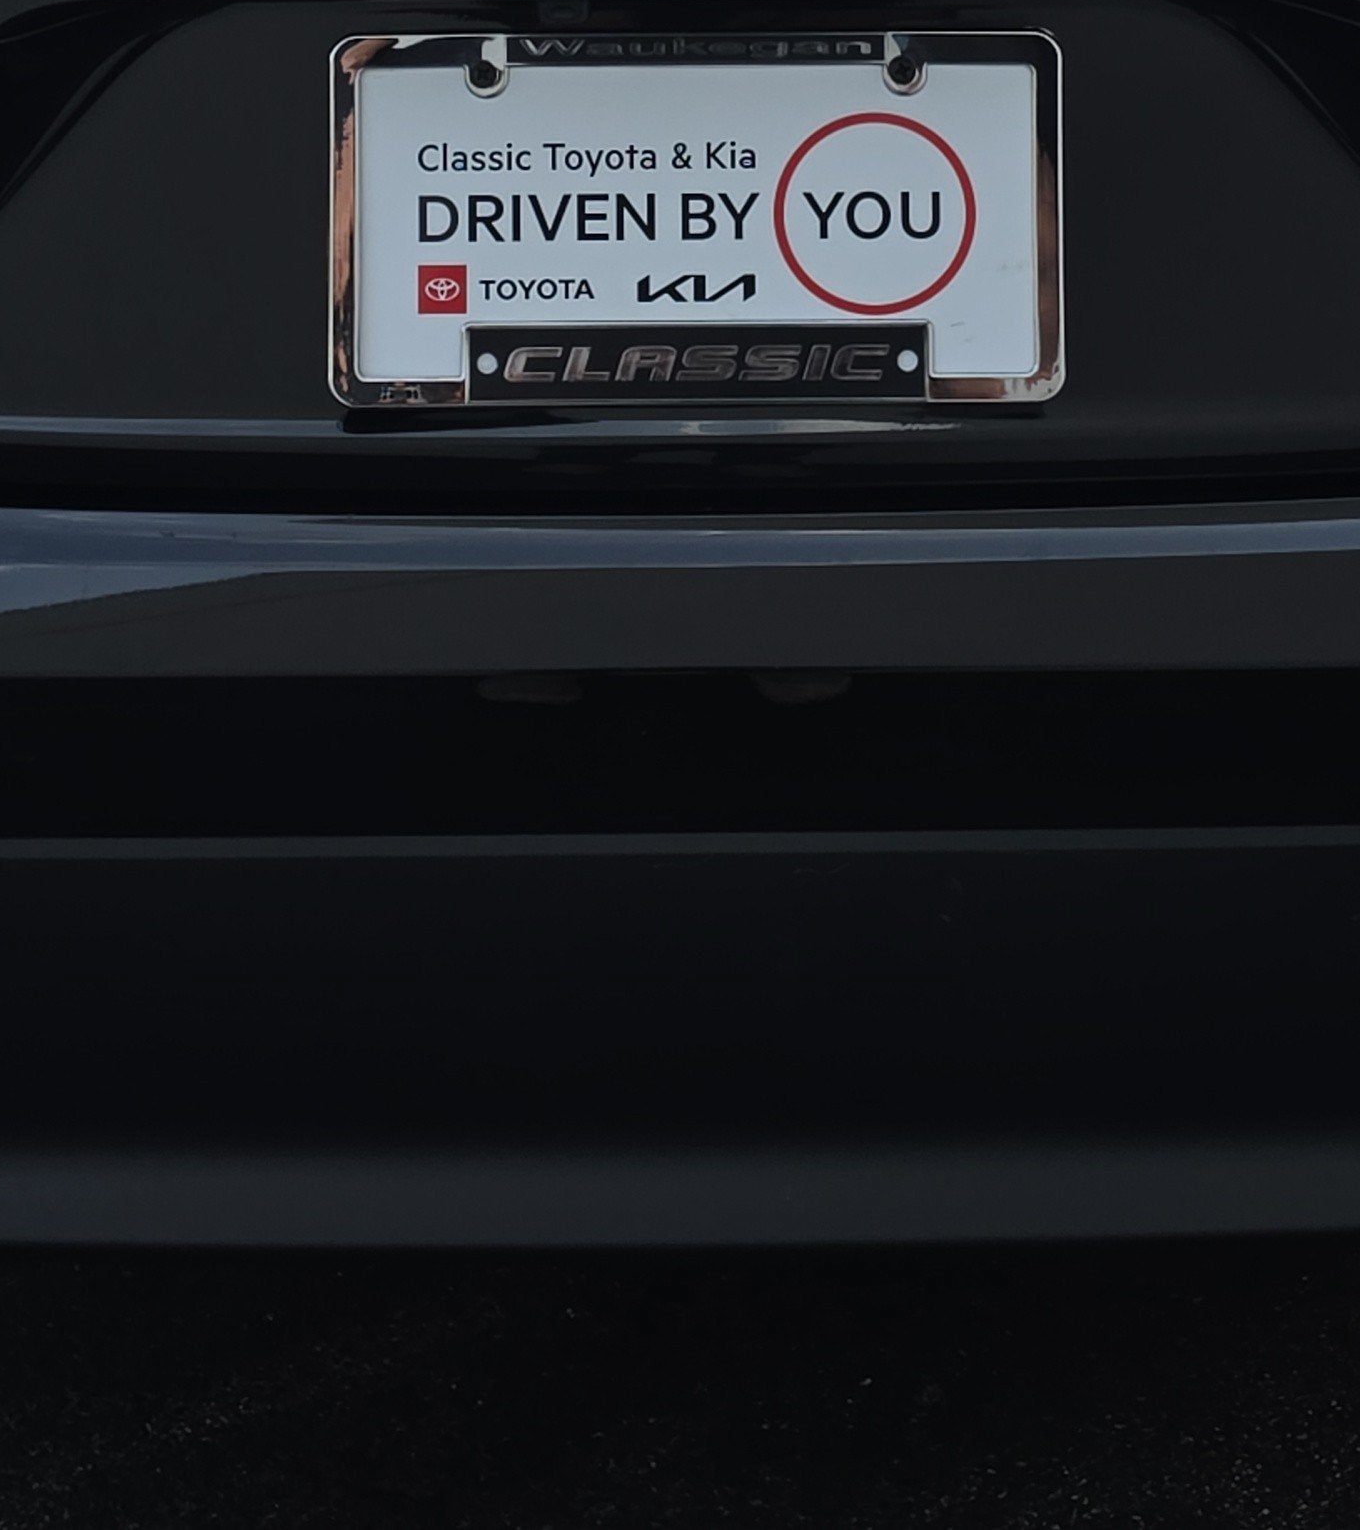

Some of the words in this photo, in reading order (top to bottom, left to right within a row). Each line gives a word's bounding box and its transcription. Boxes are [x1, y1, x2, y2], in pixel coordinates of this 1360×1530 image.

[518, 36, 873, 58] Waukegan
[417, 142, 532, 171] Classic
[542, 142, 657, 177] Toyota
[671, 142, 693, 170] &
[705, 141, 757, 169] Kia
[417, 193, 657, 243] DRIVEN
[680, 191, 760, 241] BY
[803, 190, 943, 240] YOU
[478, 279, 595, 301] TOYOTA
[502, 344, 891, 383] CLASSIC
